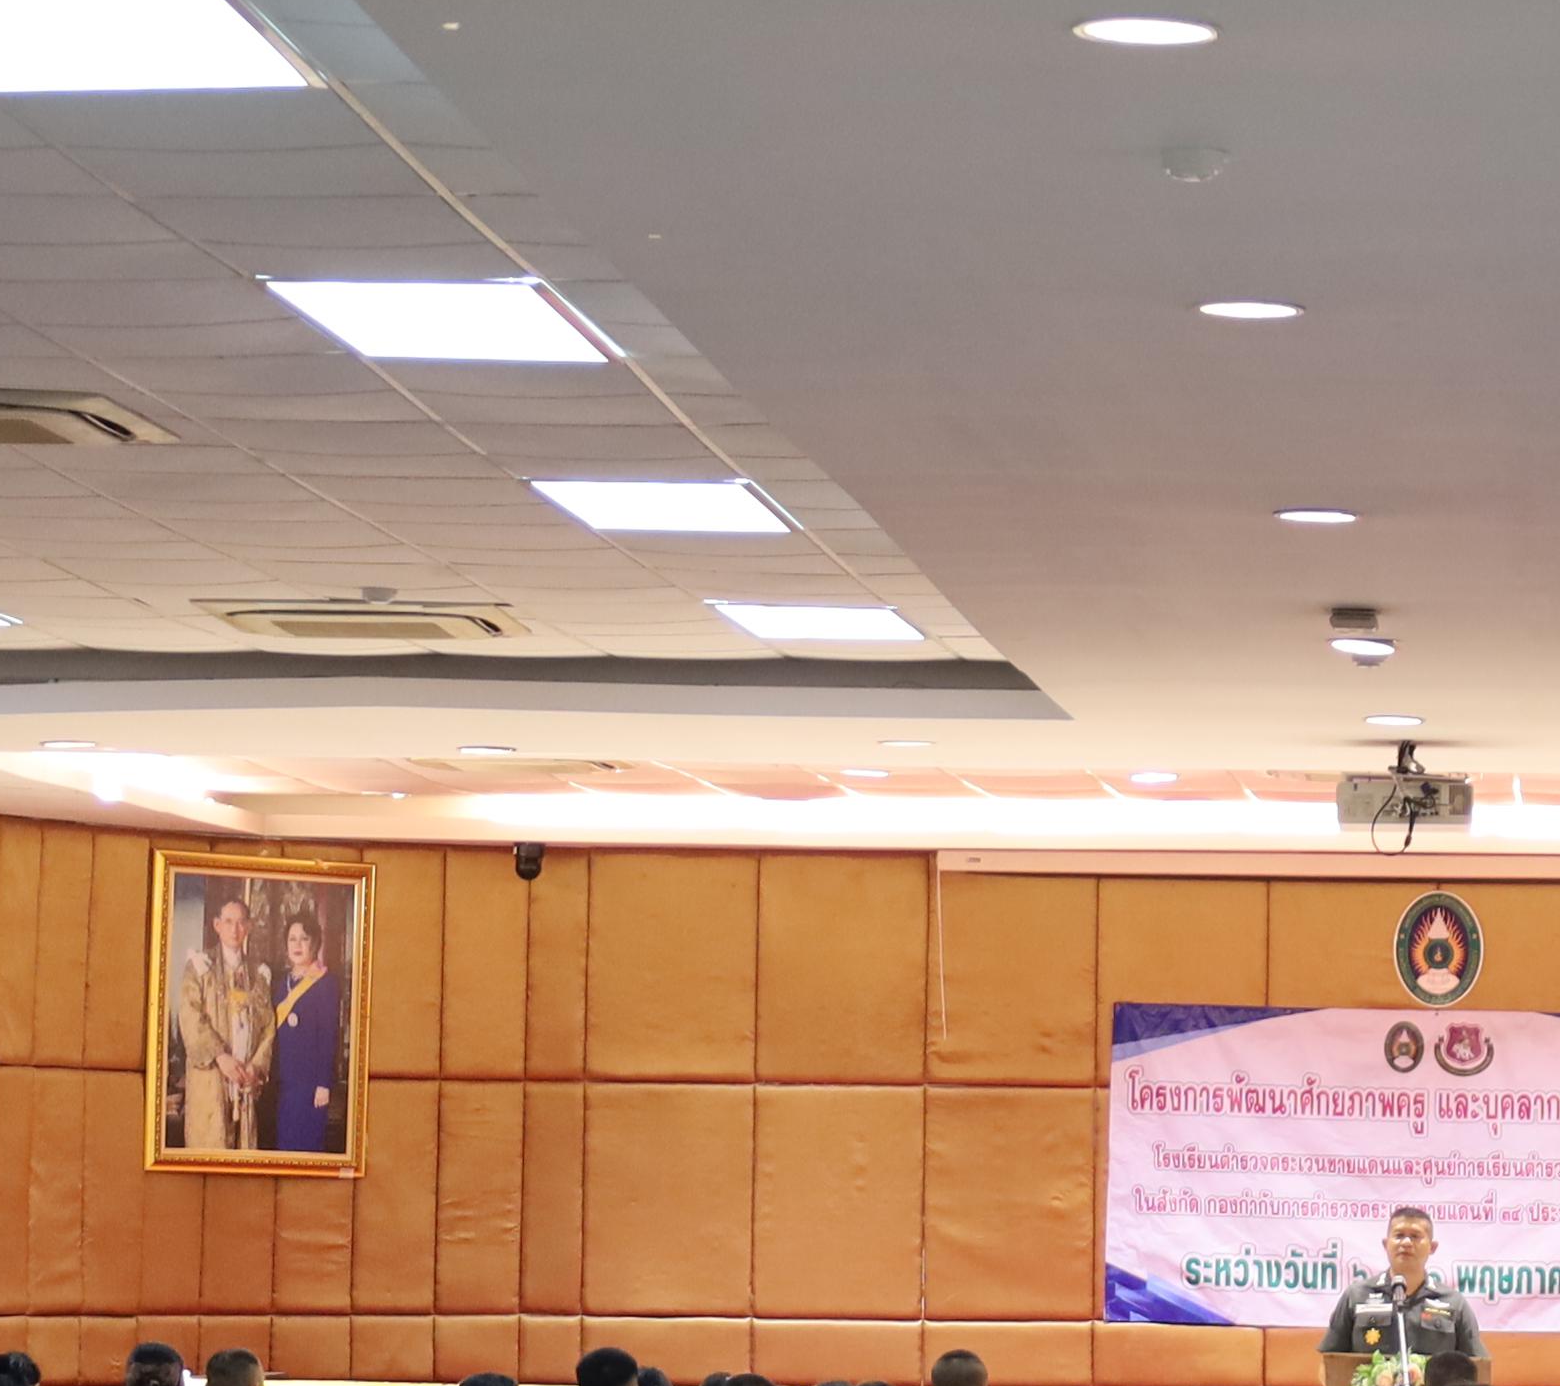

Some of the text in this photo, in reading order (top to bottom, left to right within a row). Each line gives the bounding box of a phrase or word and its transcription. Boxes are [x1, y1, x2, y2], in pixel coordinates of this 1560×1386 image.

[1127, 1069, 1426, 1134] โครงการพัฒนาศักยภาพครู
[1134, 1187, 1199, 1213] ในสังกัด
[1185, 1242, 1338, 1290] ระหว่างวันที่
